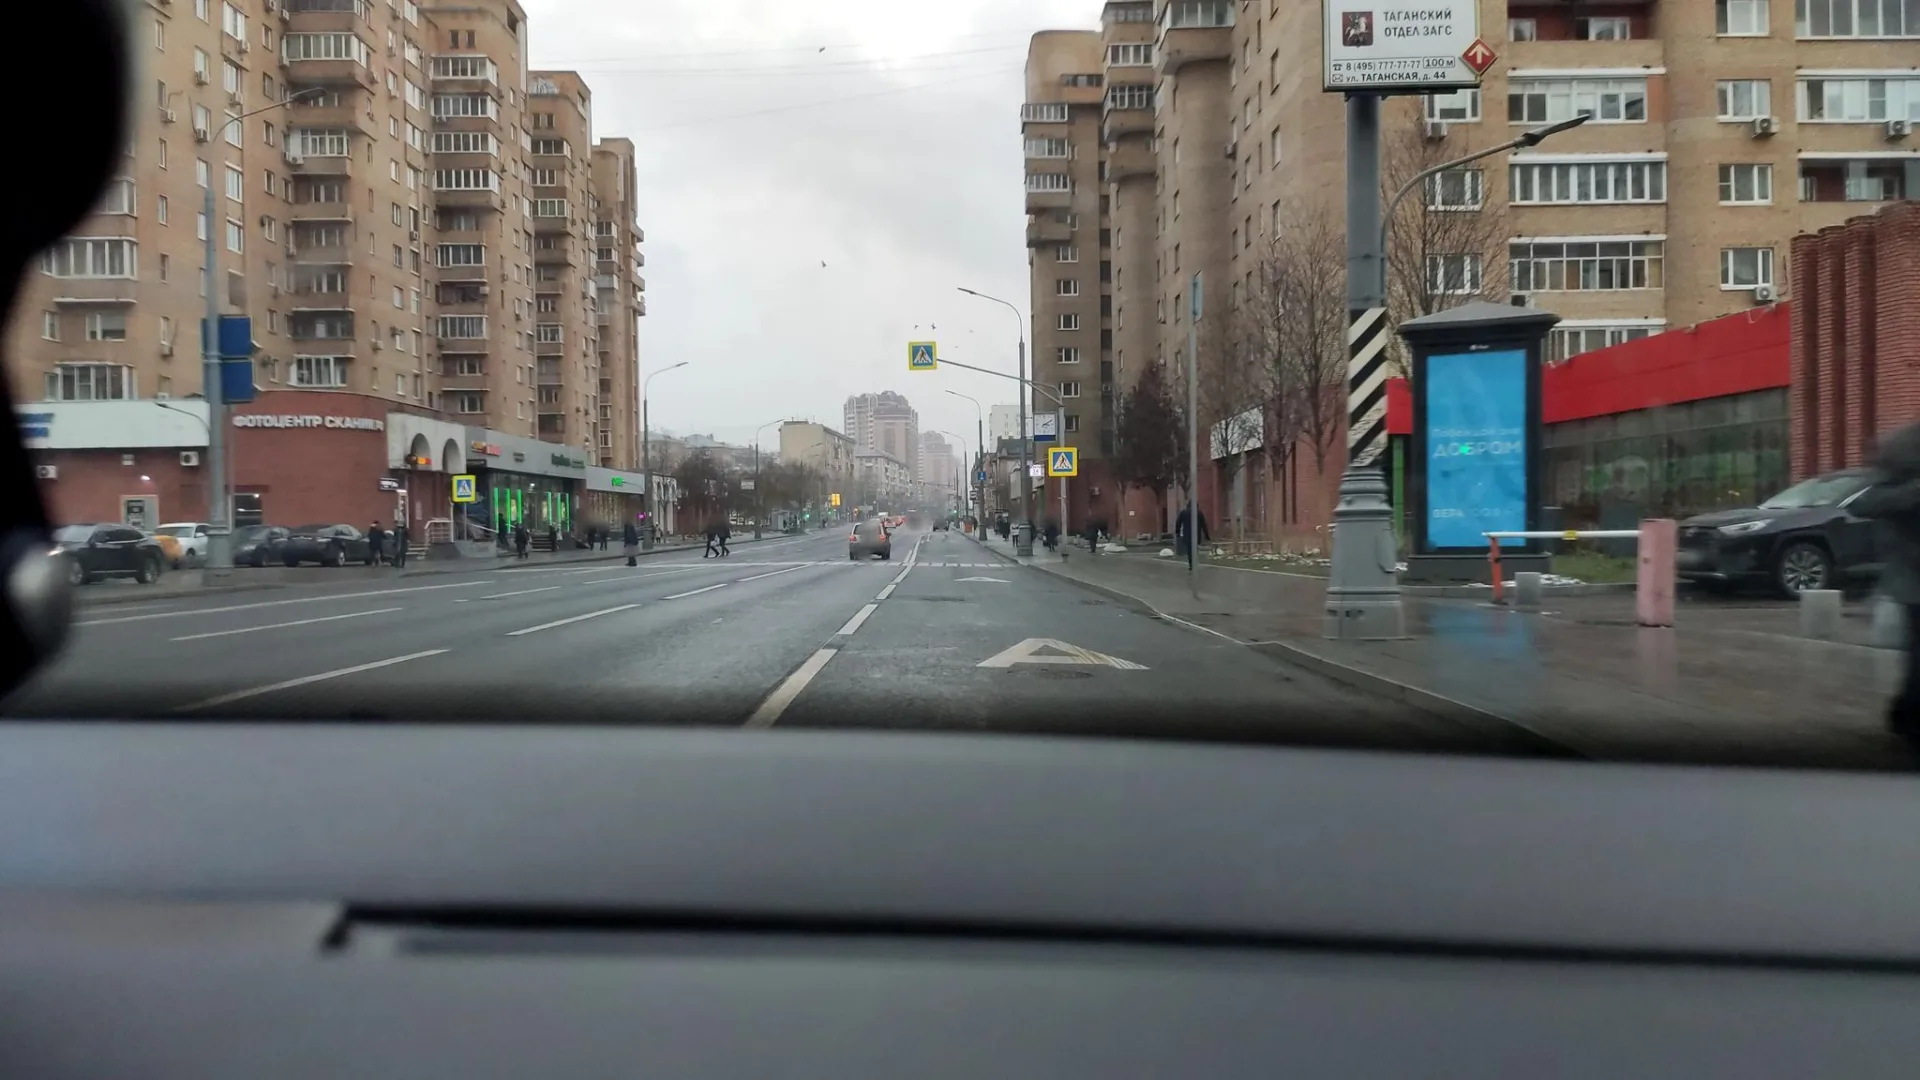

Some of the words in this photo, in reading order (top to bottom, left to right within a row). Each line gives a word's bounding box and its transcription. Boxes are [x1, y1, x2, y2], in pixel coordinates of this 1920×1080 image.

[1383, 8, 1452, 21] ТАГАНСКИЙ
[1384, 26, 1420, 38] ОТДЕЛ
[1423, 25, 1453, 37] ЗАГС
[1353, 62, 1376, 71] (495)
[1378, 61, 1421, 71] 777-77-77
[1425, 58, 1445, 67] 100
[1433, 71, 1446, 79] 44
[232, 414, 323, 428] ФОТОЦЕНТР
